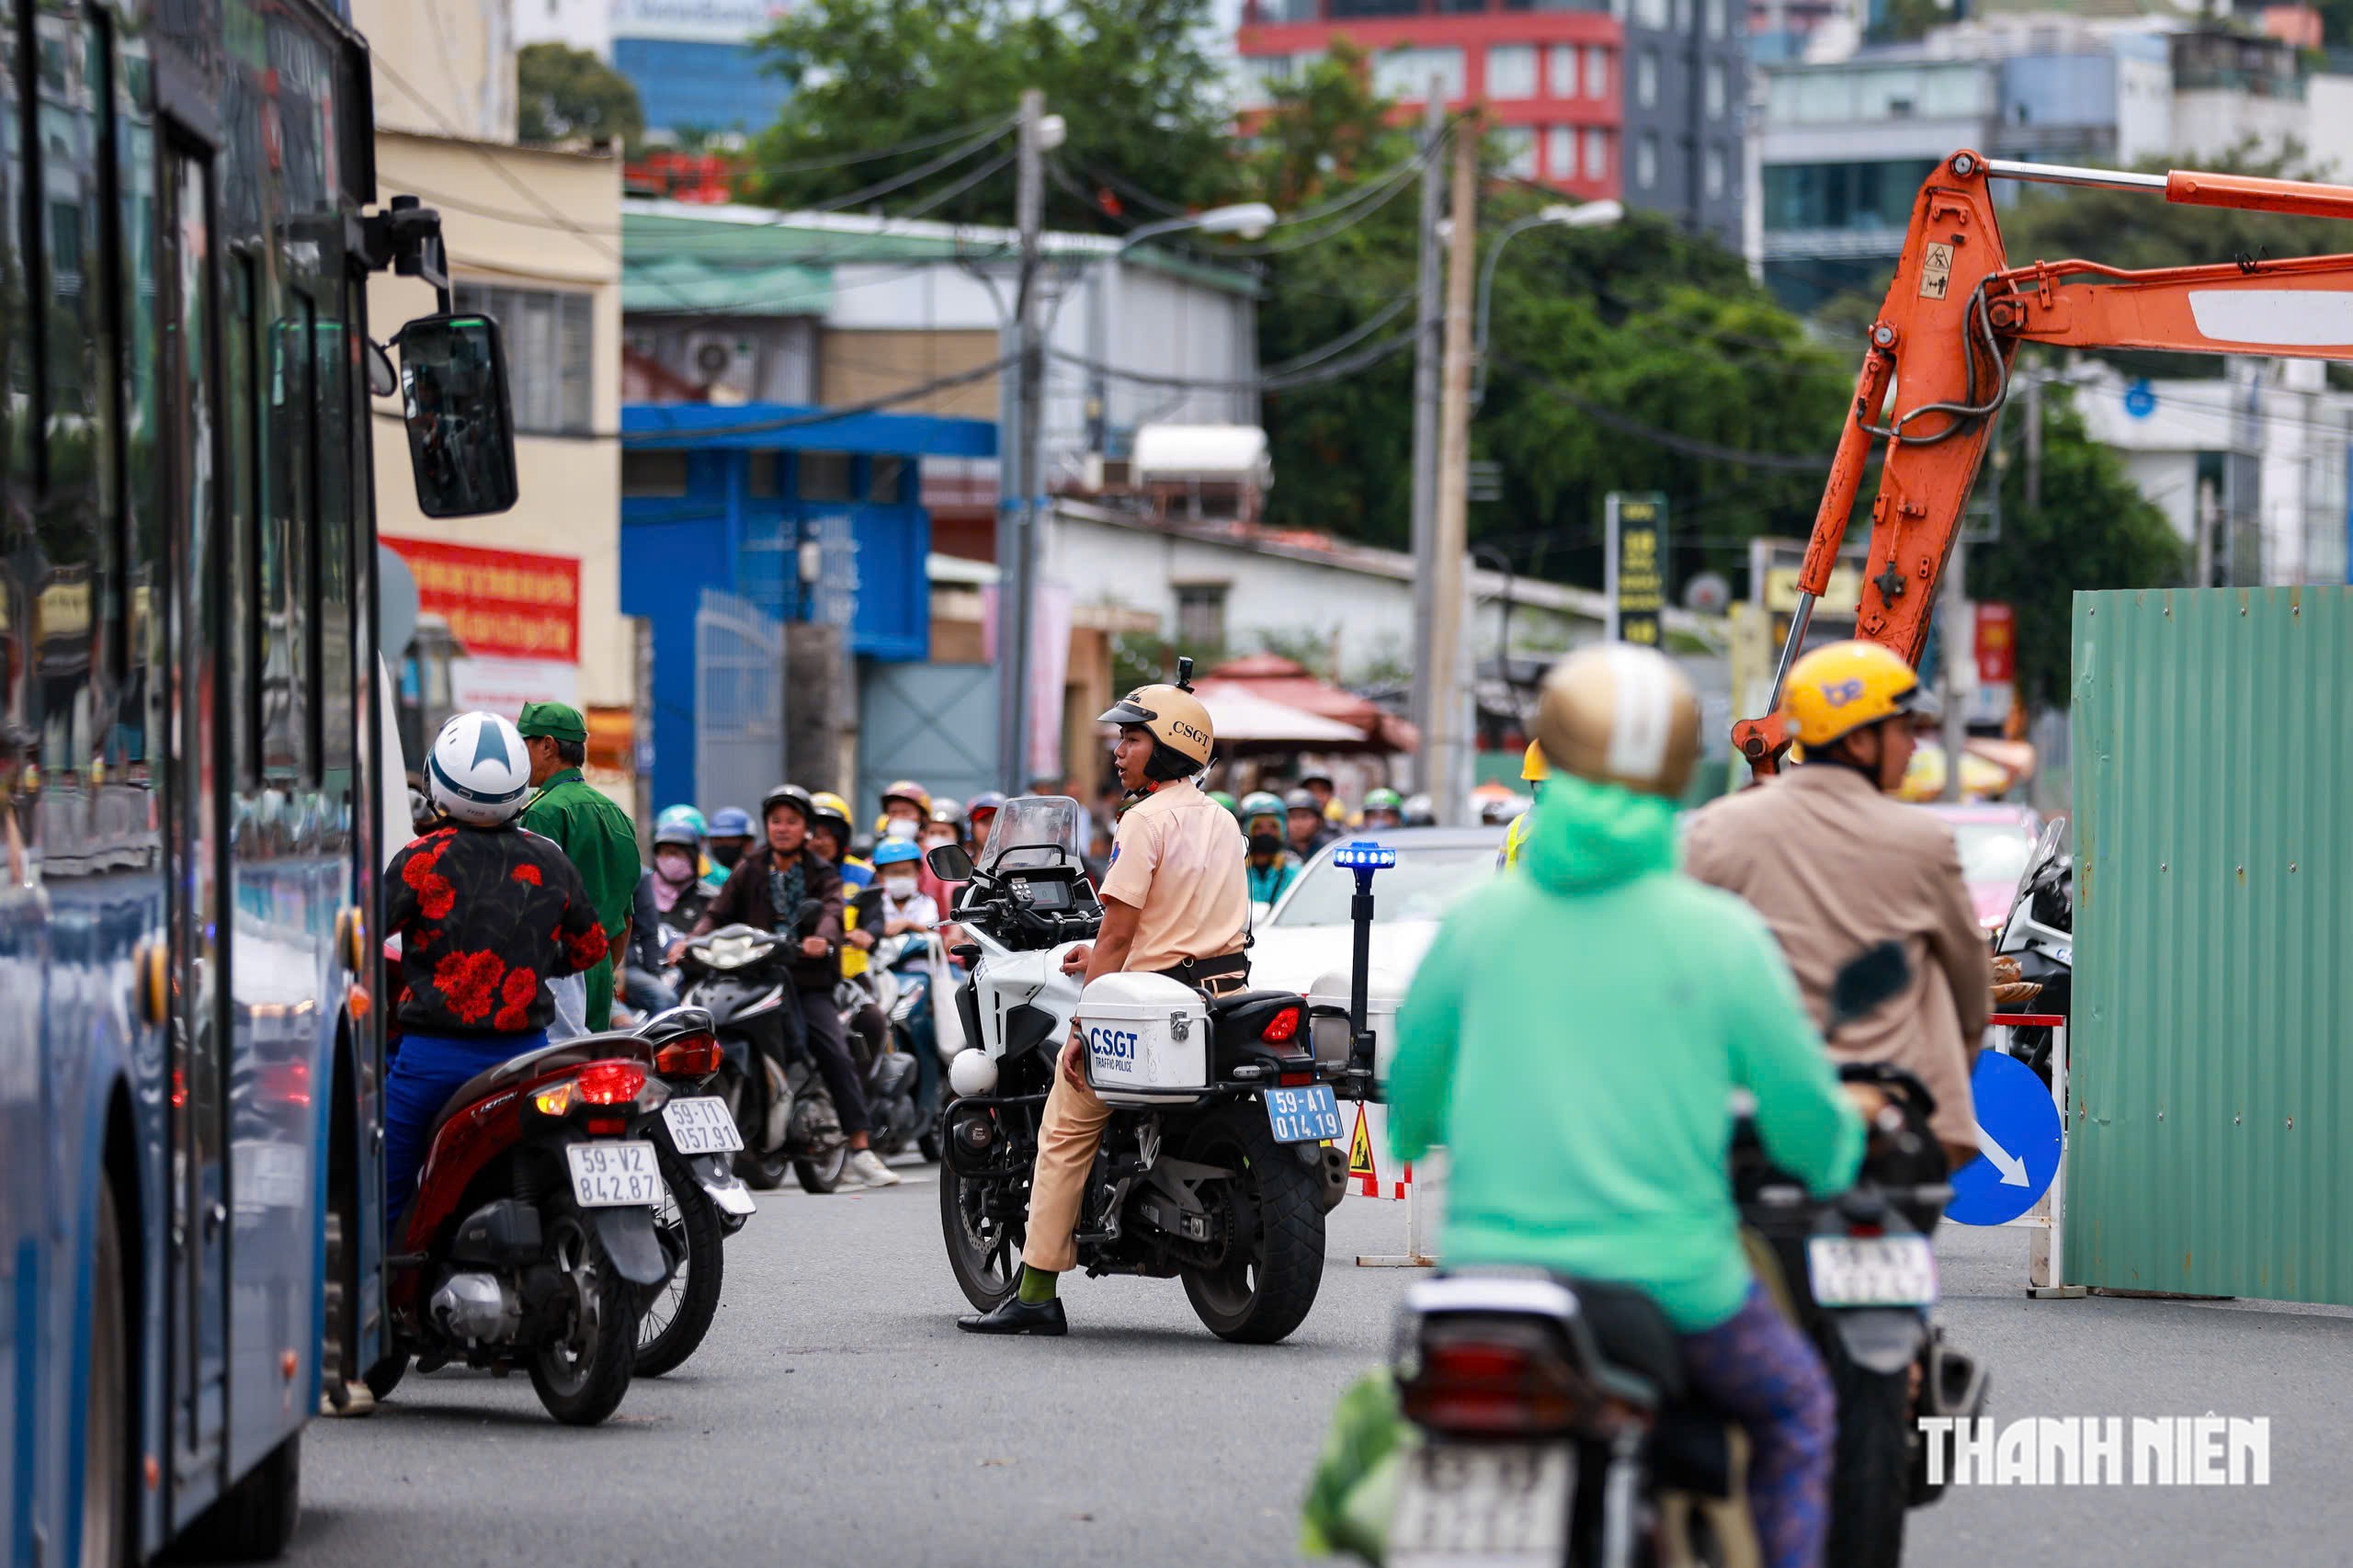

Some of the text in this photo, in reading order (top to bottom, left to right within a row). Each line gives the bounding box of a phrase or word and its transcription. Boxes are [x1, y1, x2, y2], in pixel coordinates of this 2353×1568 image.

[1172, 721, 1210, 747] CSGT
[1096, 1056, 1132, 1073] TRAFFIC POLICE
[670, 1101, 721, 1126] 59-T1
[1275, 1088, 1326, 1114] 59-A1
[676, 1125, 736, 1149] 057.91
[1276, 1112, 1338, 1139] 014.19
[581, 1147, 644, 1174] 59-V2
[579, 1175, 654, 1202] 842.87
